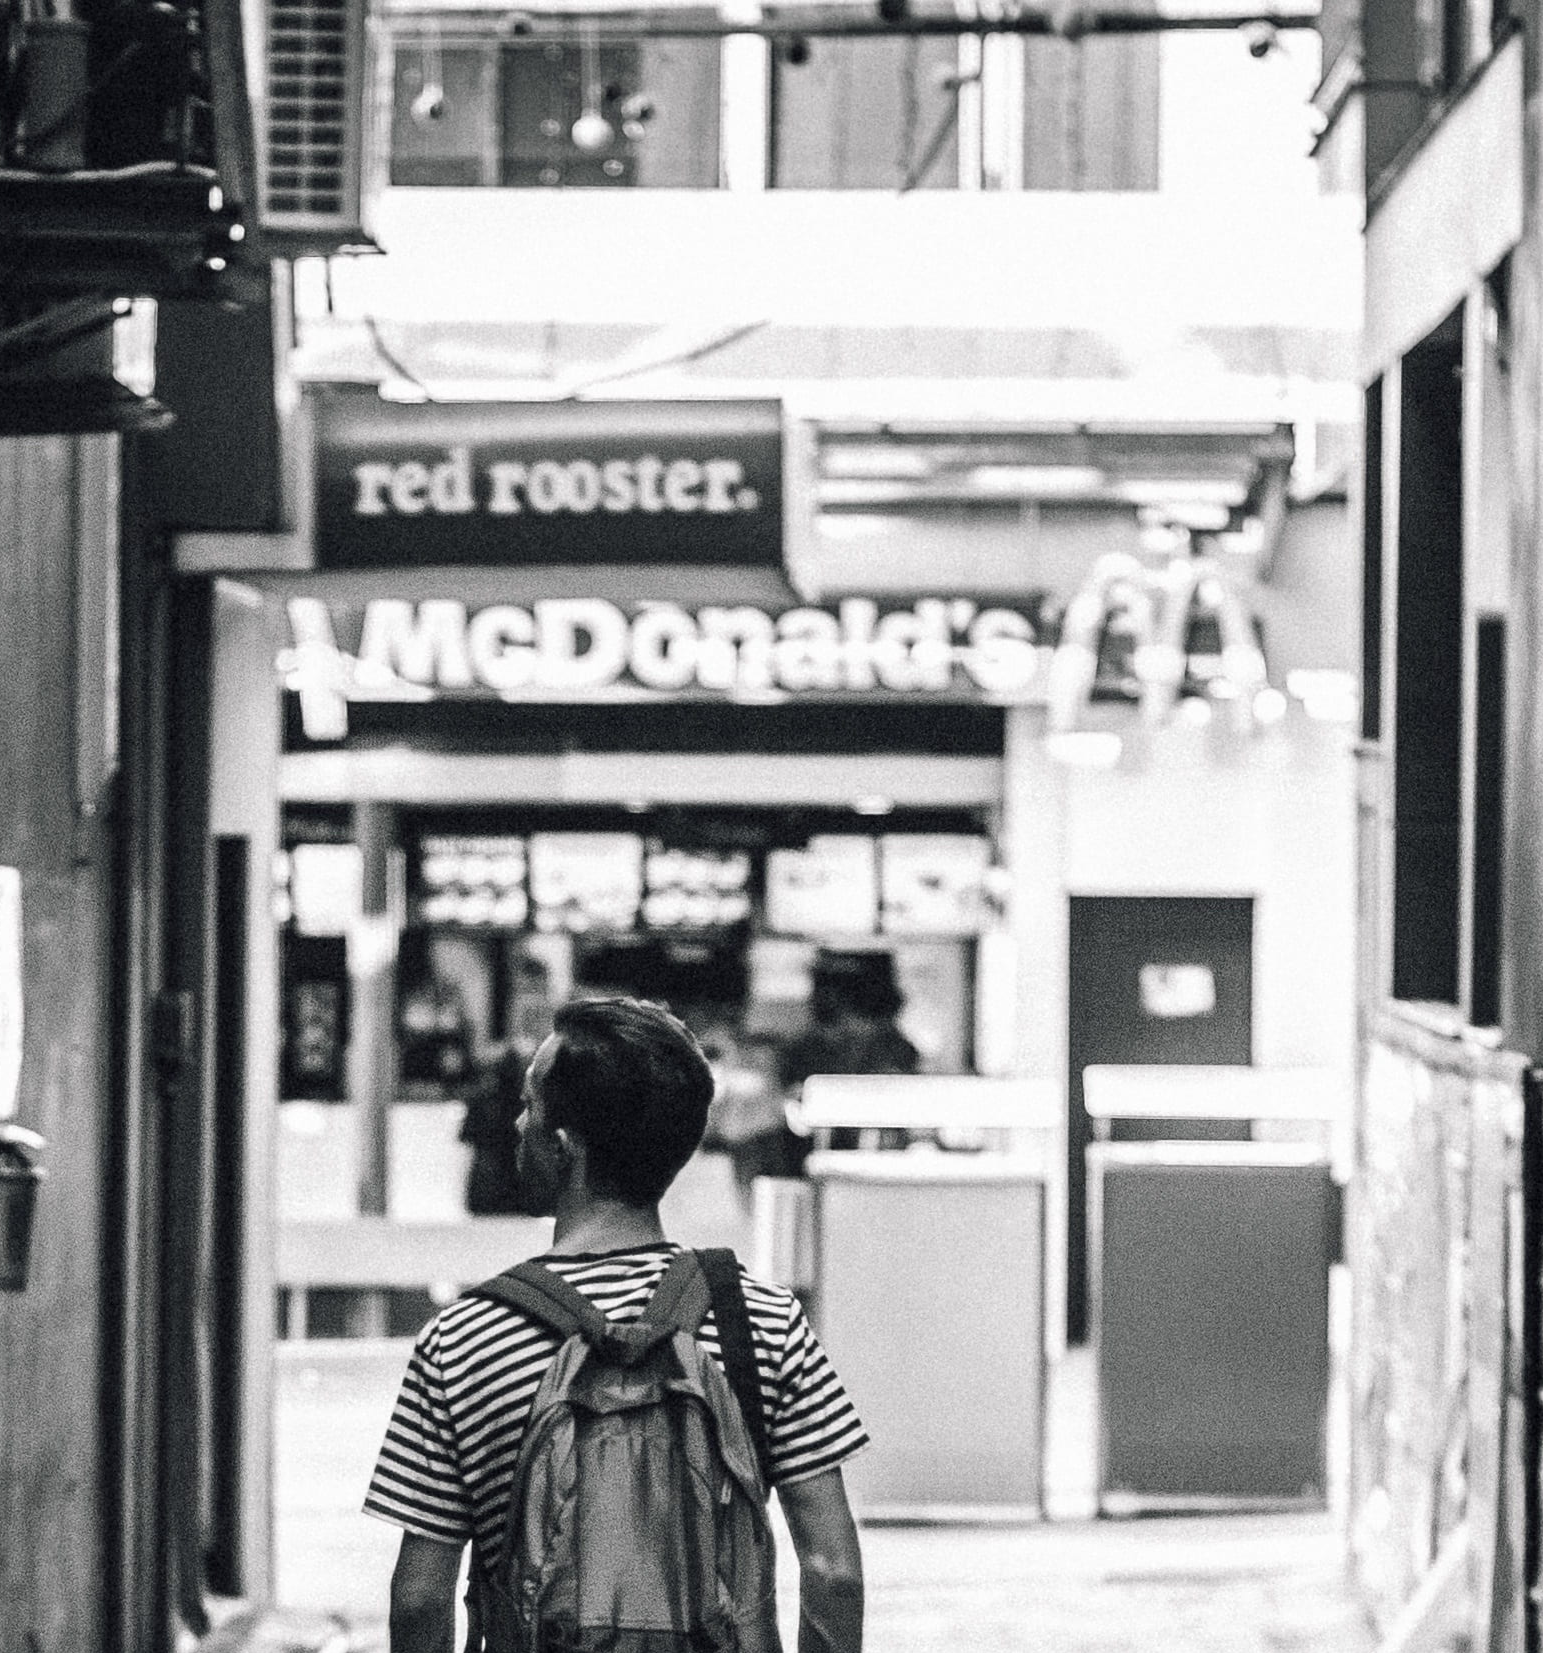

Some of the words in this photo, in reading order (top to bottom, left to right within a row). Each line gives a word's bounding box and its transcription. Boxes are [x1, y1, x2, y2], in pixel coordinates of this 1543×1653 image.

[355, 445, 474, 514] red
[488, 455, 758, 513] rooster.
[358, 597, 1038, 691] McDonald's
